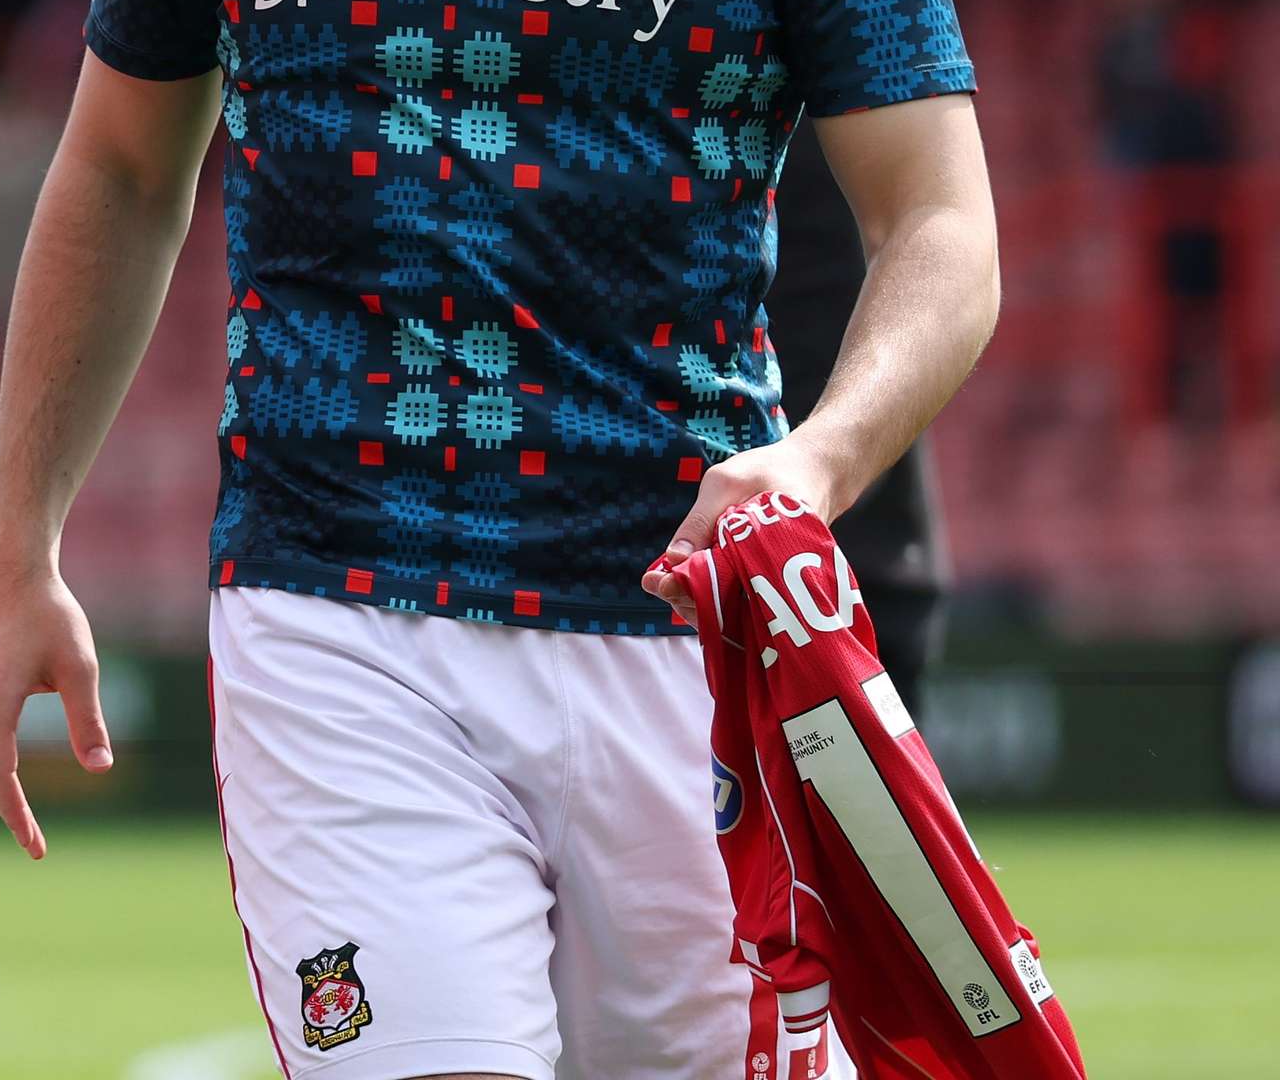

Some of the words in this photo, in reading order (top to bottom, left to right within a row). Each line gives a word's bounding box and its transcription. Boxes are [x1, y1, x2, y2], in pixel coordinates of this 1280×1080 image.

[802, 730, 821, 745] THE
[1030, 978, 1046, 994] EFL
[976, 1009, 1000, 1025] EFL
